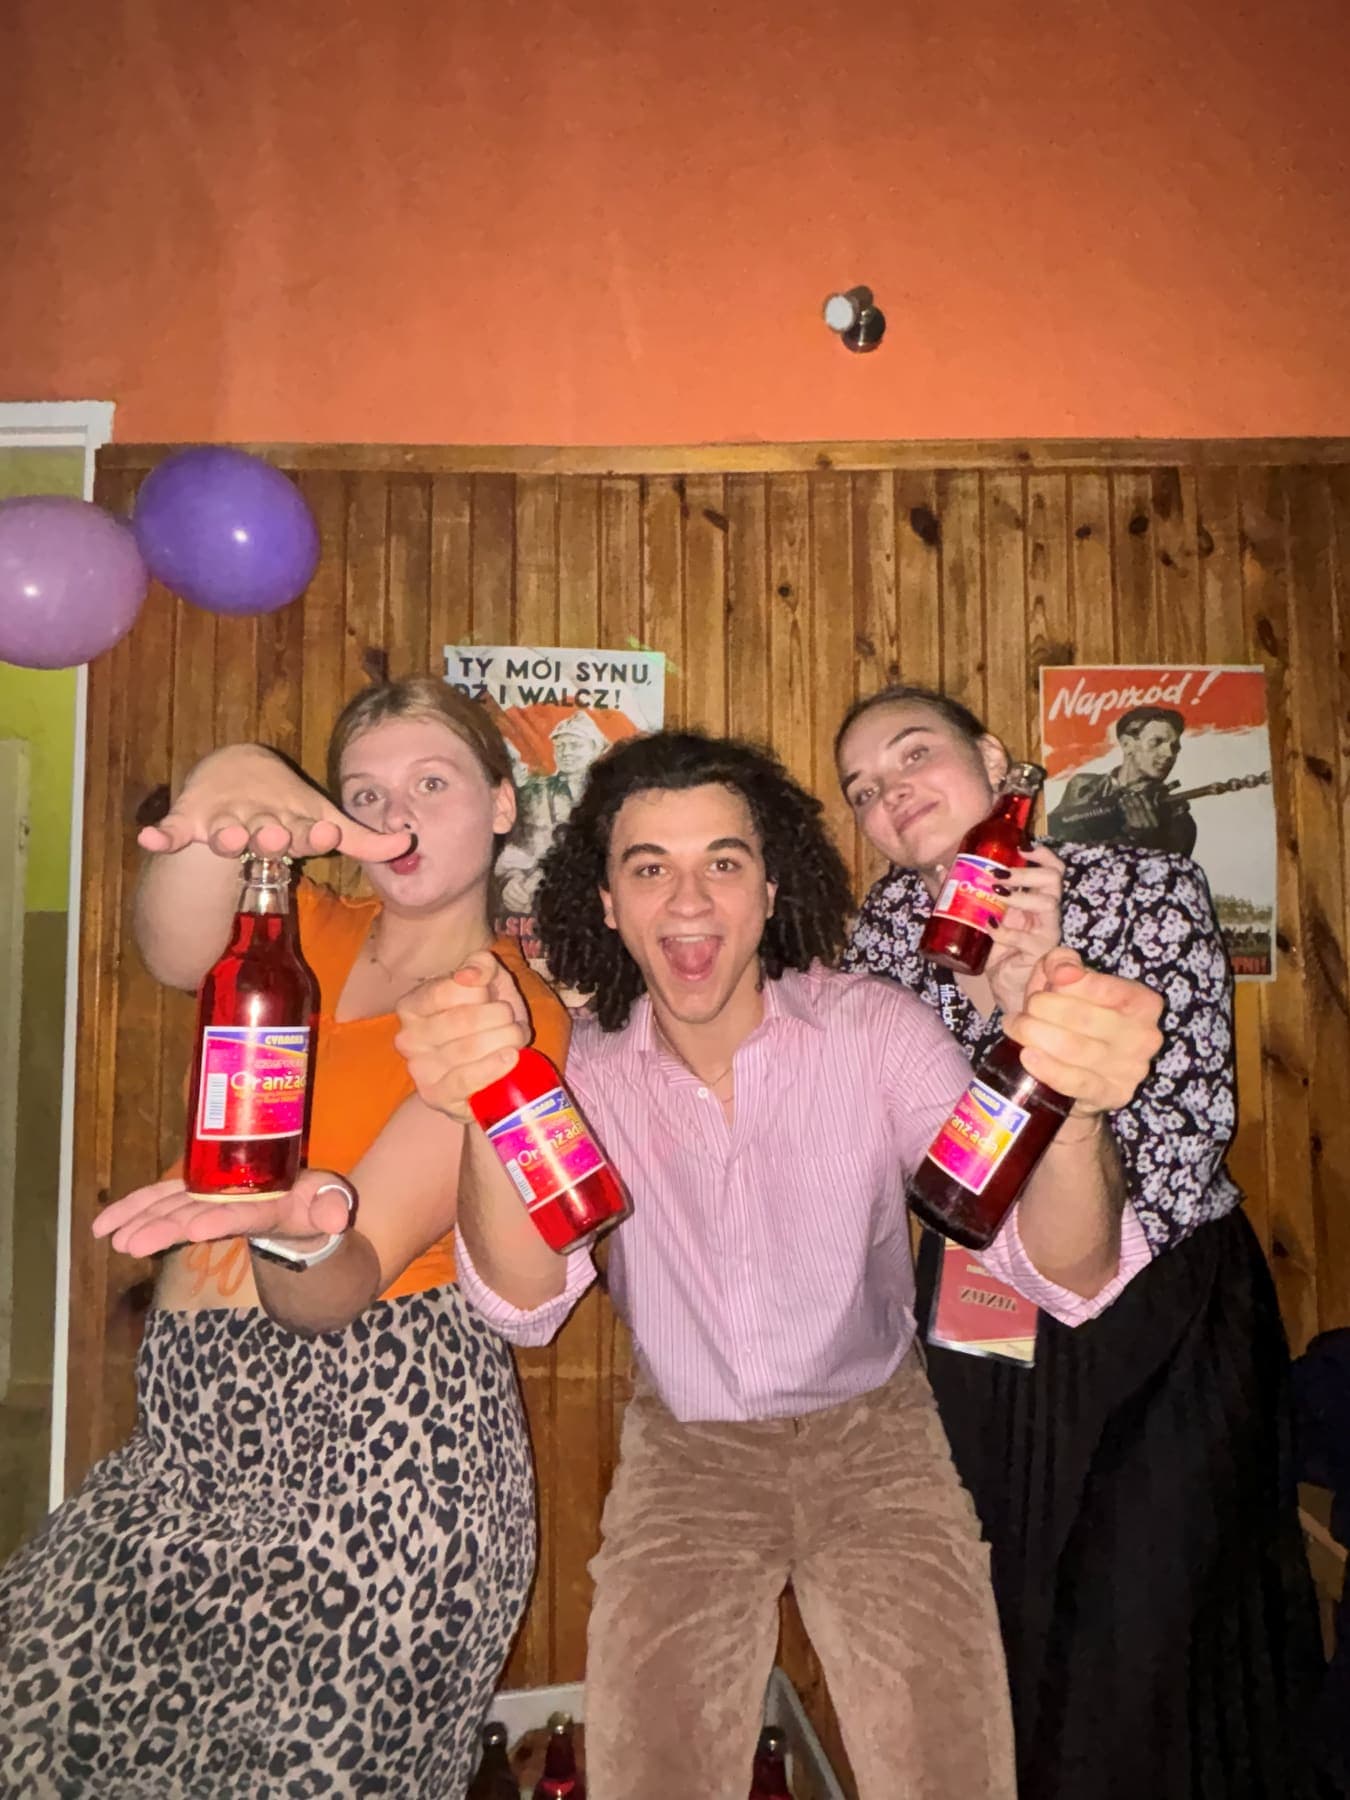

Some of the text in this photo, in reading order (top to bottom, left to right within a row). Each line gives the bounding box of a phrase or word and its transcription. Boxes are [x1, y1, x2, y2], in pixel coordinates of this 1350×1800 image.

[459, 657, 494, 678] TY
[506, 656, 561, 682] MÓJ
[576, 661, 652, 686] SYNU,
[499, 685, 506, 704] I
[518, 685, 621, 709] WALCZ!
